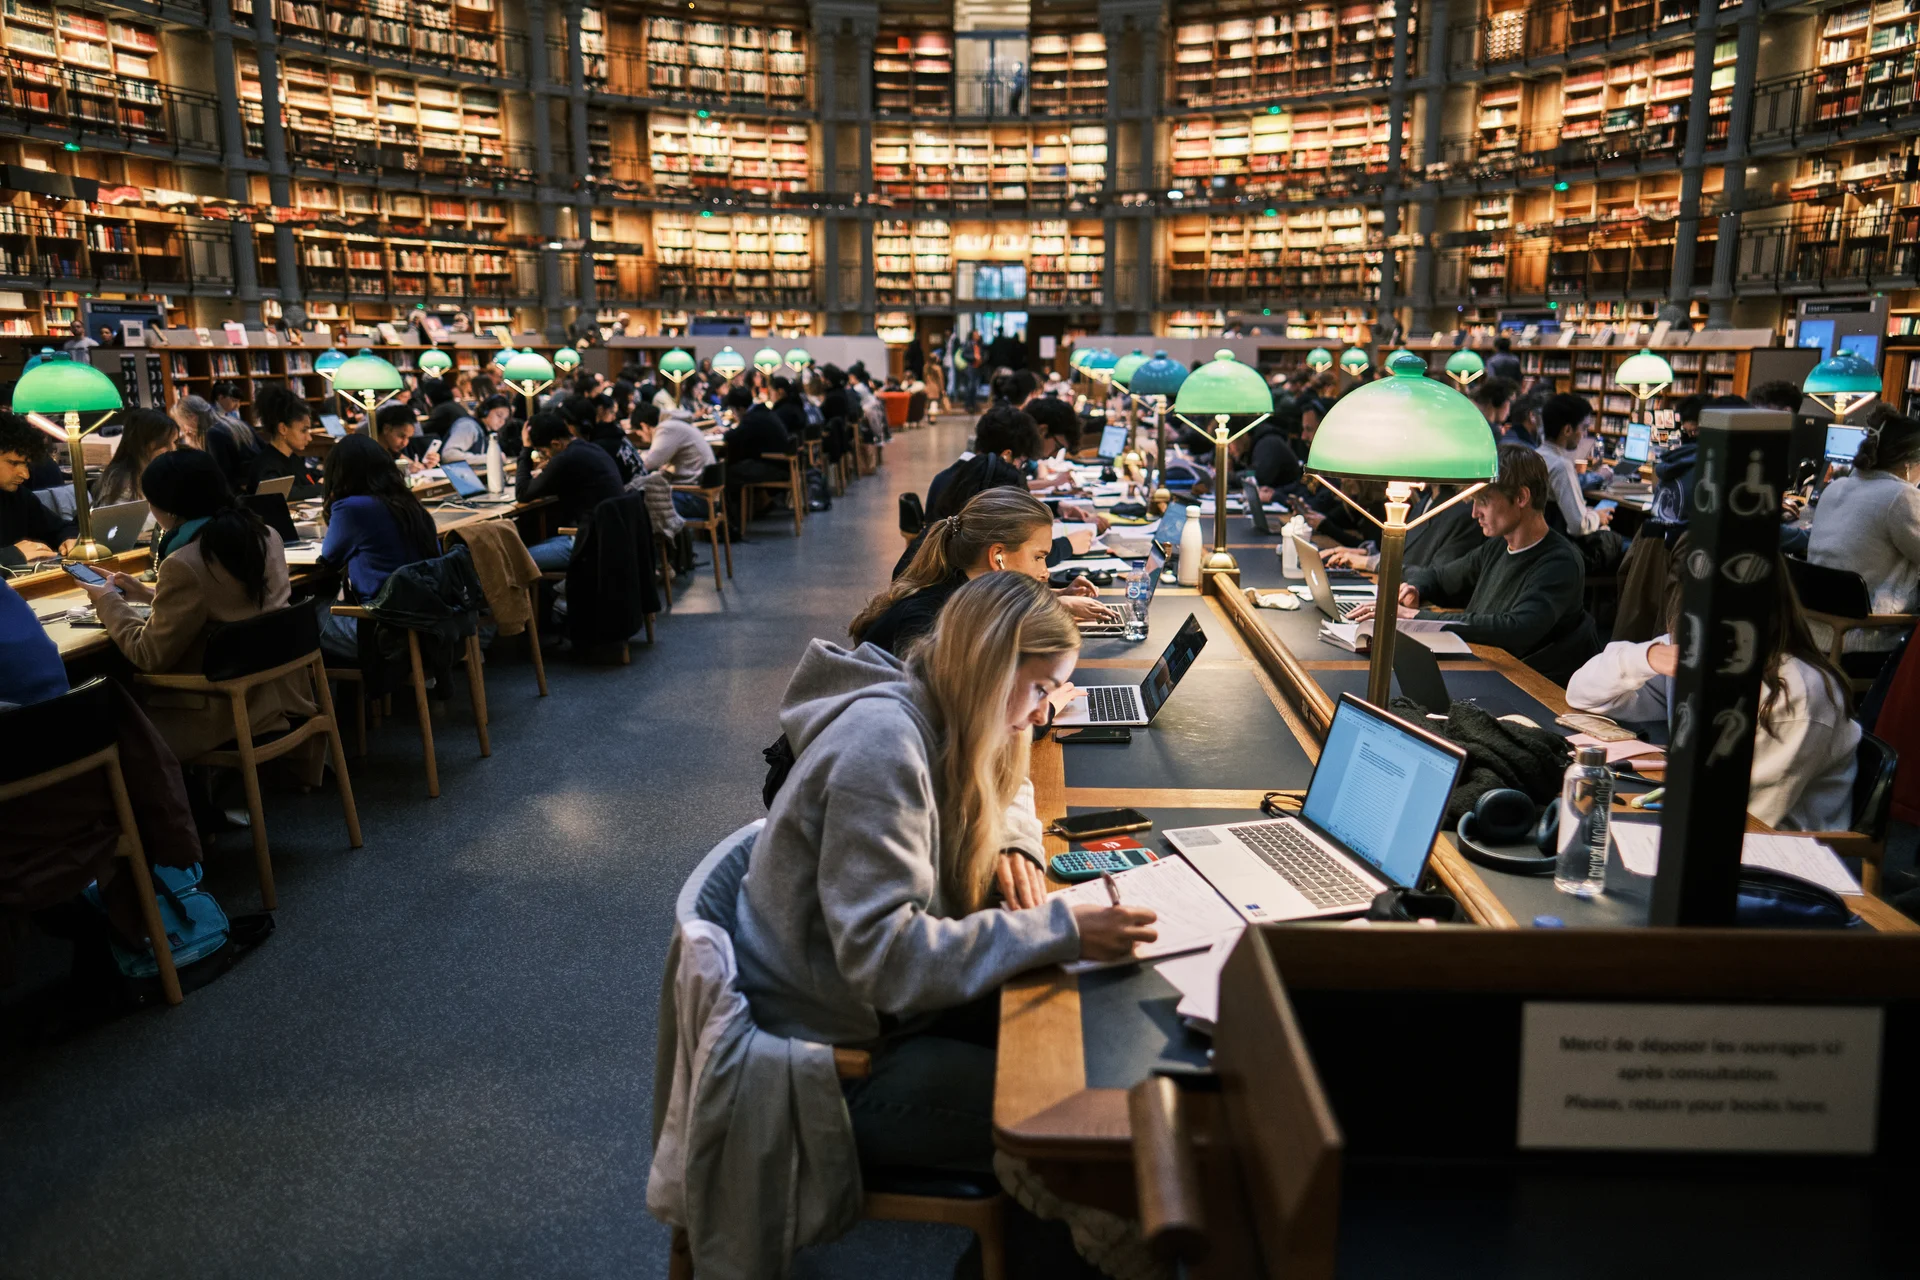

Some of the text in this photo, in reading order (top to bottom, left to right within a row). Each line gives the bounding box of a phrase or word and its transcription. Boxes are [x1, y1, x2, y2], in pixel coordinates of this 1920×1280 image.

[1560, 1036, 1608, 1052] Merci
[1613, 1037, 1634, 1052] de
[1638, 1036, 1707, 1056] déposer
[1711, 1038, 1735, 1054] les
[1739, 1040, 1818, 1058] ouvrages
[1618, 1064, 1777, 1081] après consultation.
[1565, 1094, 1623, 1112] Please,
[1628, 1097, 1682, 1111] return
[1686, 1099, 1724, 1114] your
[1729, 1097, 1782, 1114] books
